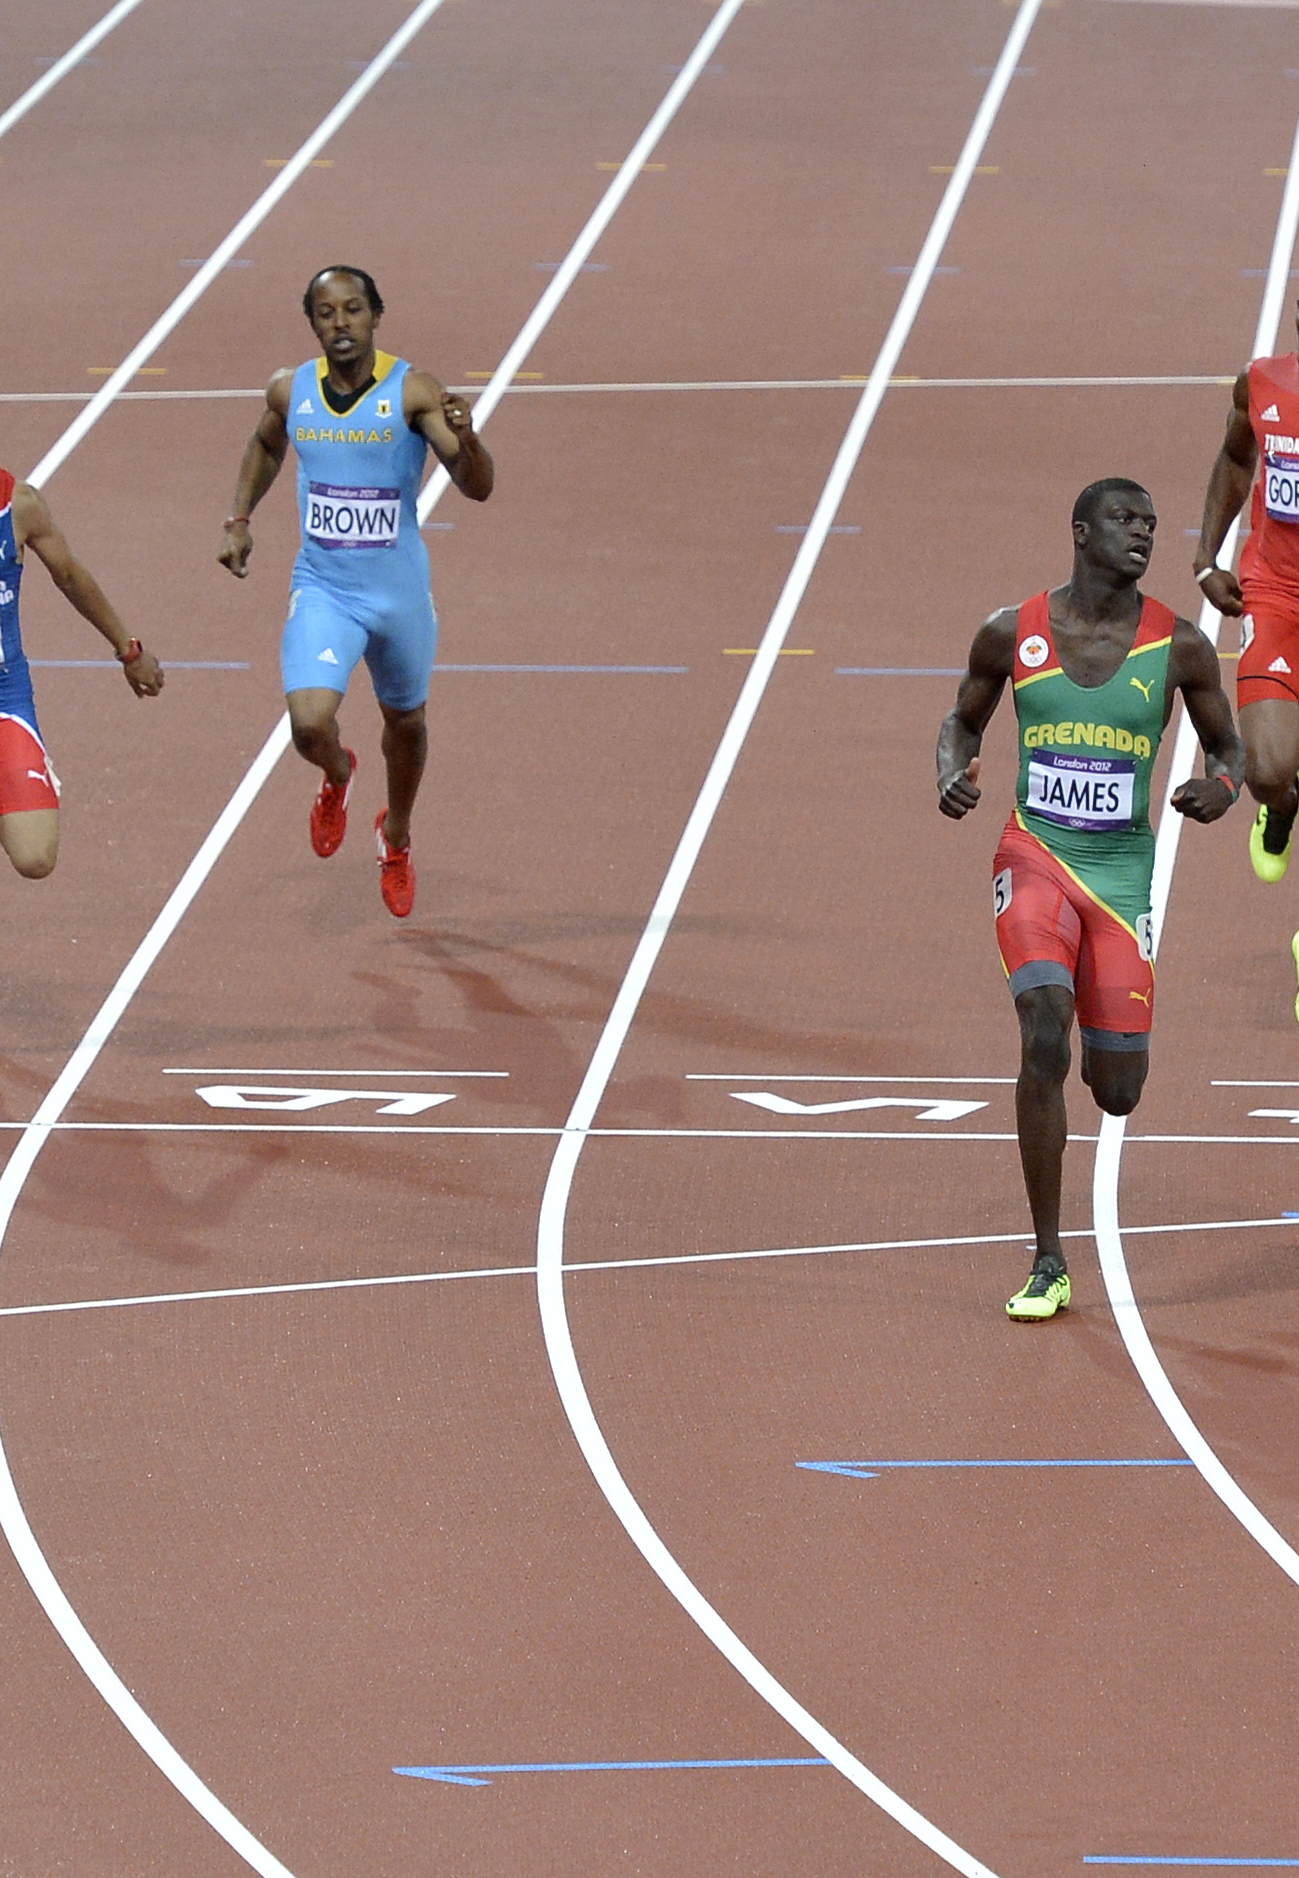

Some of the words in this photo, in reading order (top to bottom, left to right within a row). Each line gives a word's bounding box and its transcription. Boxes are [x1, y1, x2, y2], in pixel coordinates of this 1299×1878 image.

[296, 427, 393, 444] BAHAMAS
[310, 503, 395, 535] BROWN
[1024, 722, 1151, 758] GRENADA
[1053, 756, 1088, 771] London
[1088, 761, 1111, 772] 2012
[1039, 775, 1120, 813] JAMES
[995, 877, 1004, 913] 5
